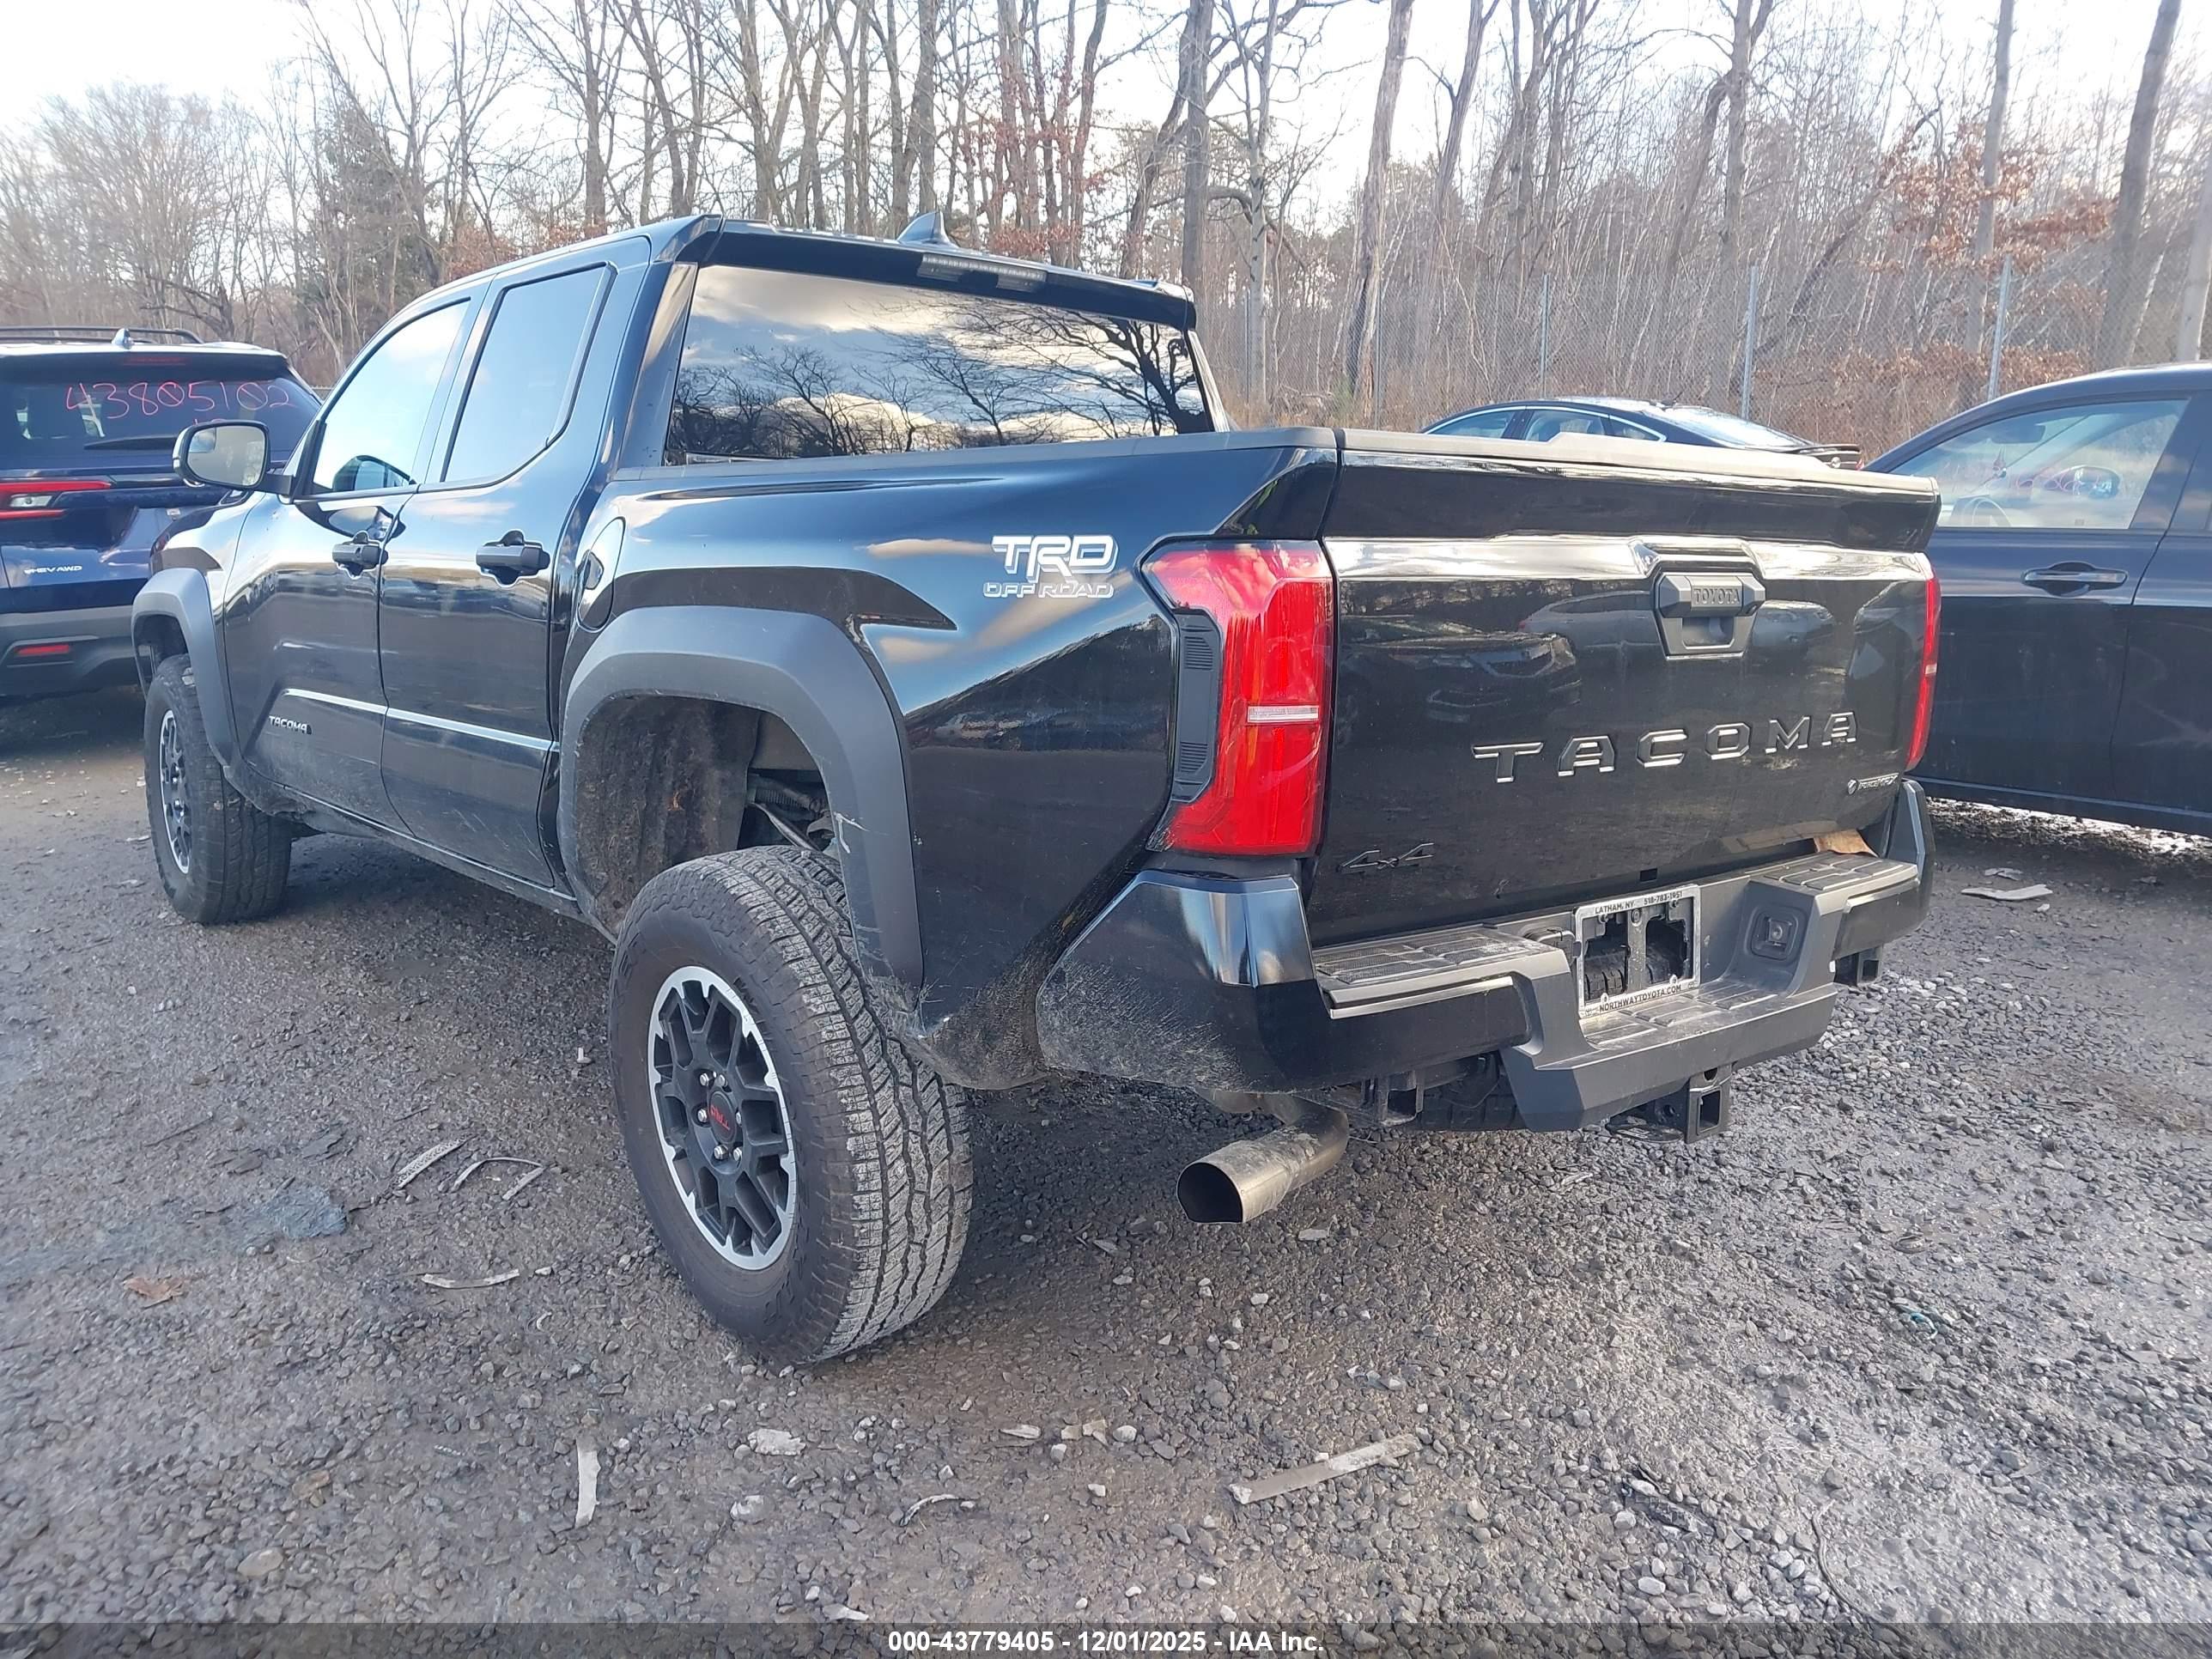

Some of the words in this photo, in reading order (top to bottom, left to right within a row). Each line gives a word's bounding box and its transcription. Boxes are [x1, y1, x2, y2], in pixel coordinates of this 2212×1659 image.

[992, 536, 1118, 583] TRD
[983, 582, 1036, 599] OFF
[1038, 580, 1115, 599] ROAD
[1692, 588, 1741, 605] TOYOTA
[269, 714, 309, 735] TACOMA
[1471, 711, 1858, 783] TACOMA
[1624, 901, 1636, 910] NY
[1599, 984, 1682, 1012] NORTHWAYTOYOTA.COM
